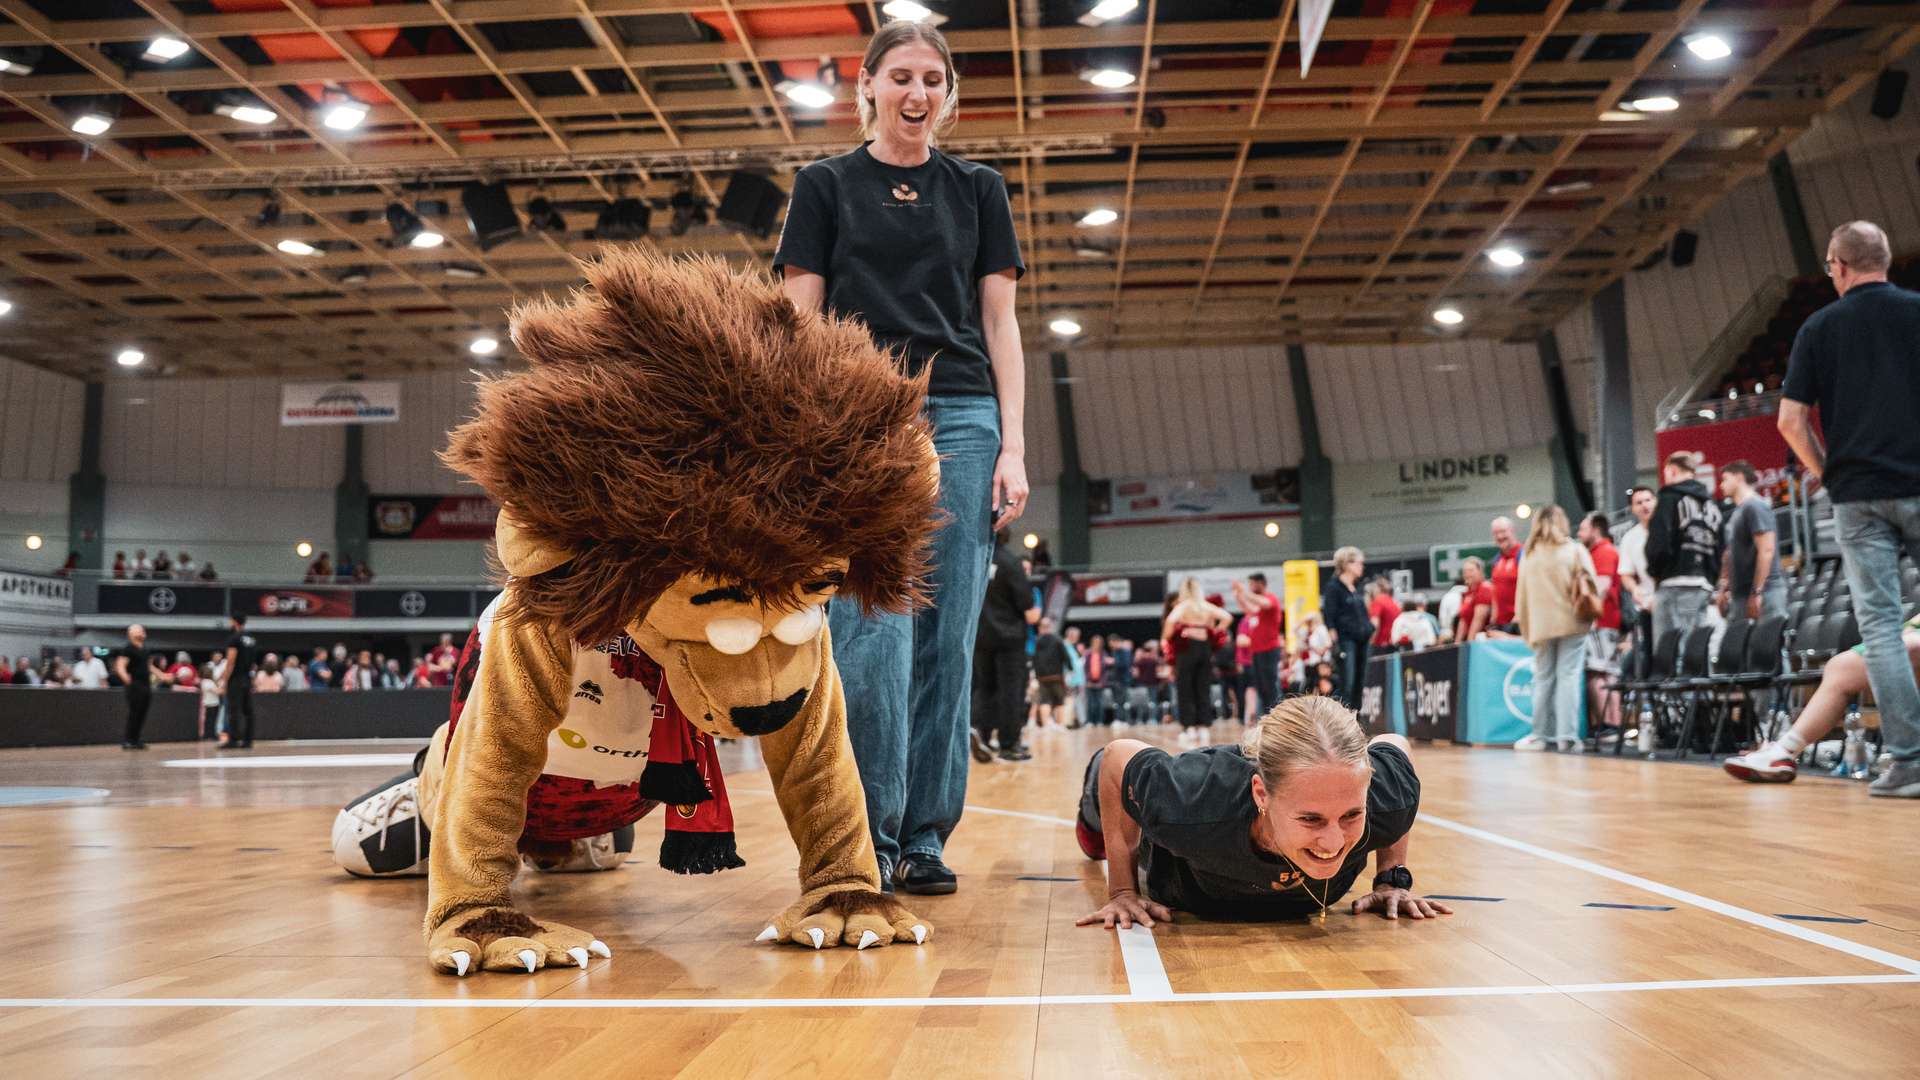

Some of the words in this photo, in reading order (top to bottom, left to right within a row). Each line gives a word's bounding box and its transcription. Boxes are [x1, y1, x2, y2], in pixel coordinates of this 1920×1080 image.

[1400, 453, 1510, 482] LINDNER
[2, 578, 72, 600] APOTHEKE
[1415, 671, 1451, 724] Bayer
